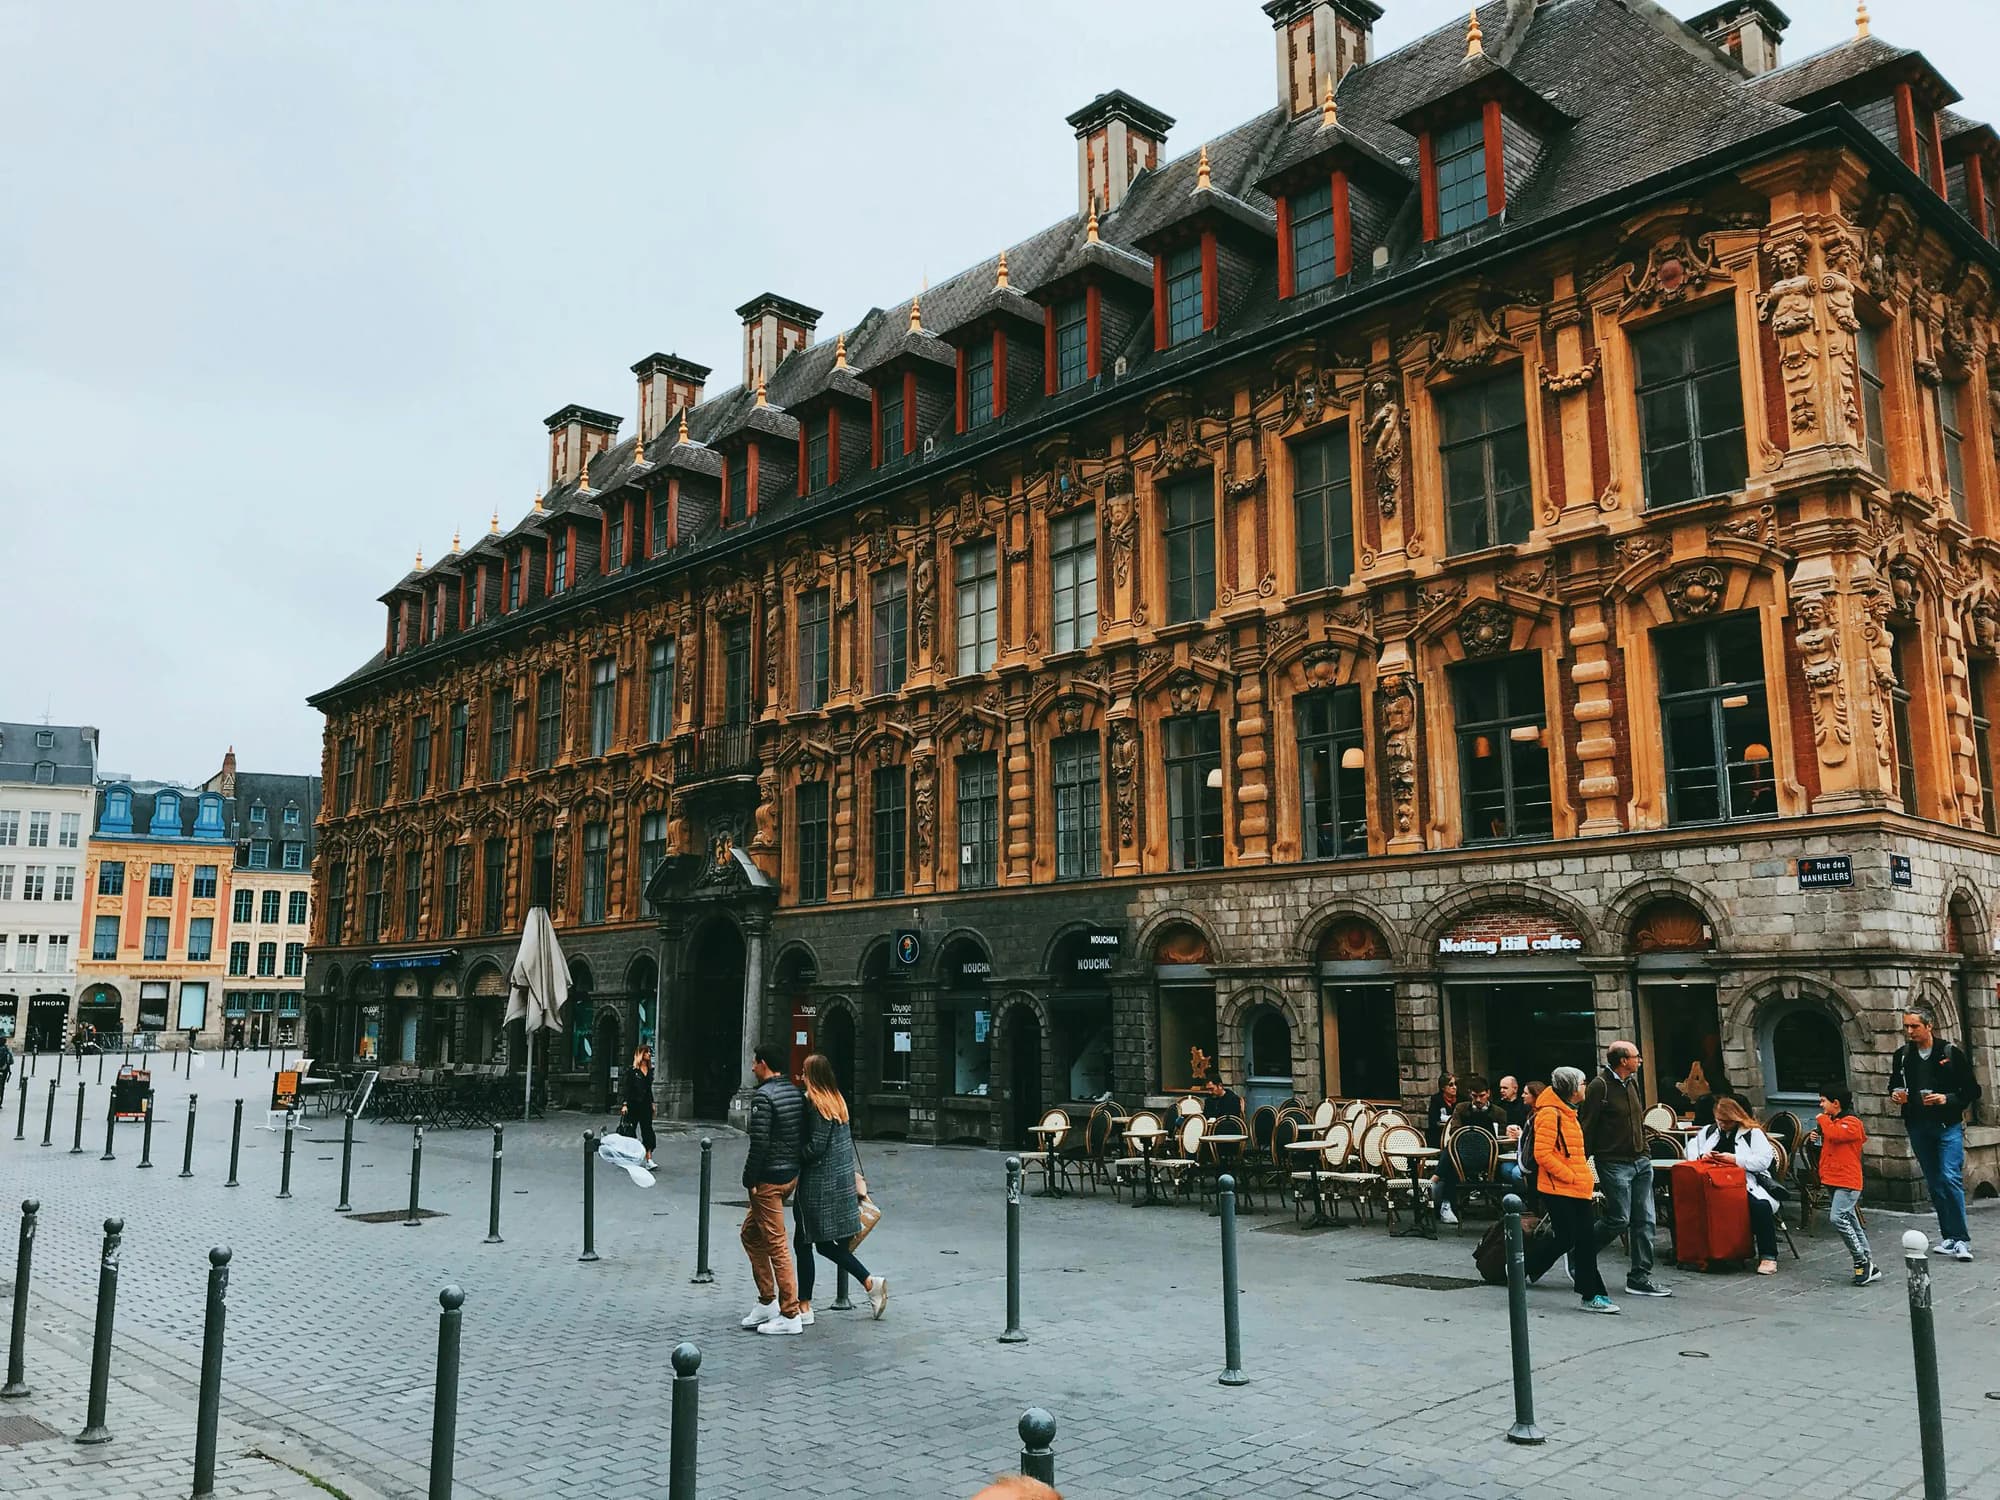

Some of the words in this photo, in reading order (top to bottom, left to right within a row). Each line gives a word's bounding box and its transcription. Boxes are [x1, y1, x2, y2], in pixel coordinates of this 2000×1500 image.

[1816, 861, 1830, 870] Rue
[1832, 860, 1846, 869] des
[1801, 871, 1850, 883] MANNELIERS
[1090, 935, 1119, 945] NOUCHKA
[1439, 937, 1498, 955] Notting
[1500, 935, 1529, 951] Hill
[1531, 934, 1582, 950] coffee
[1077, 957, 1113, 970] NOUCHK
[890, 1015, 898, 1025] de
